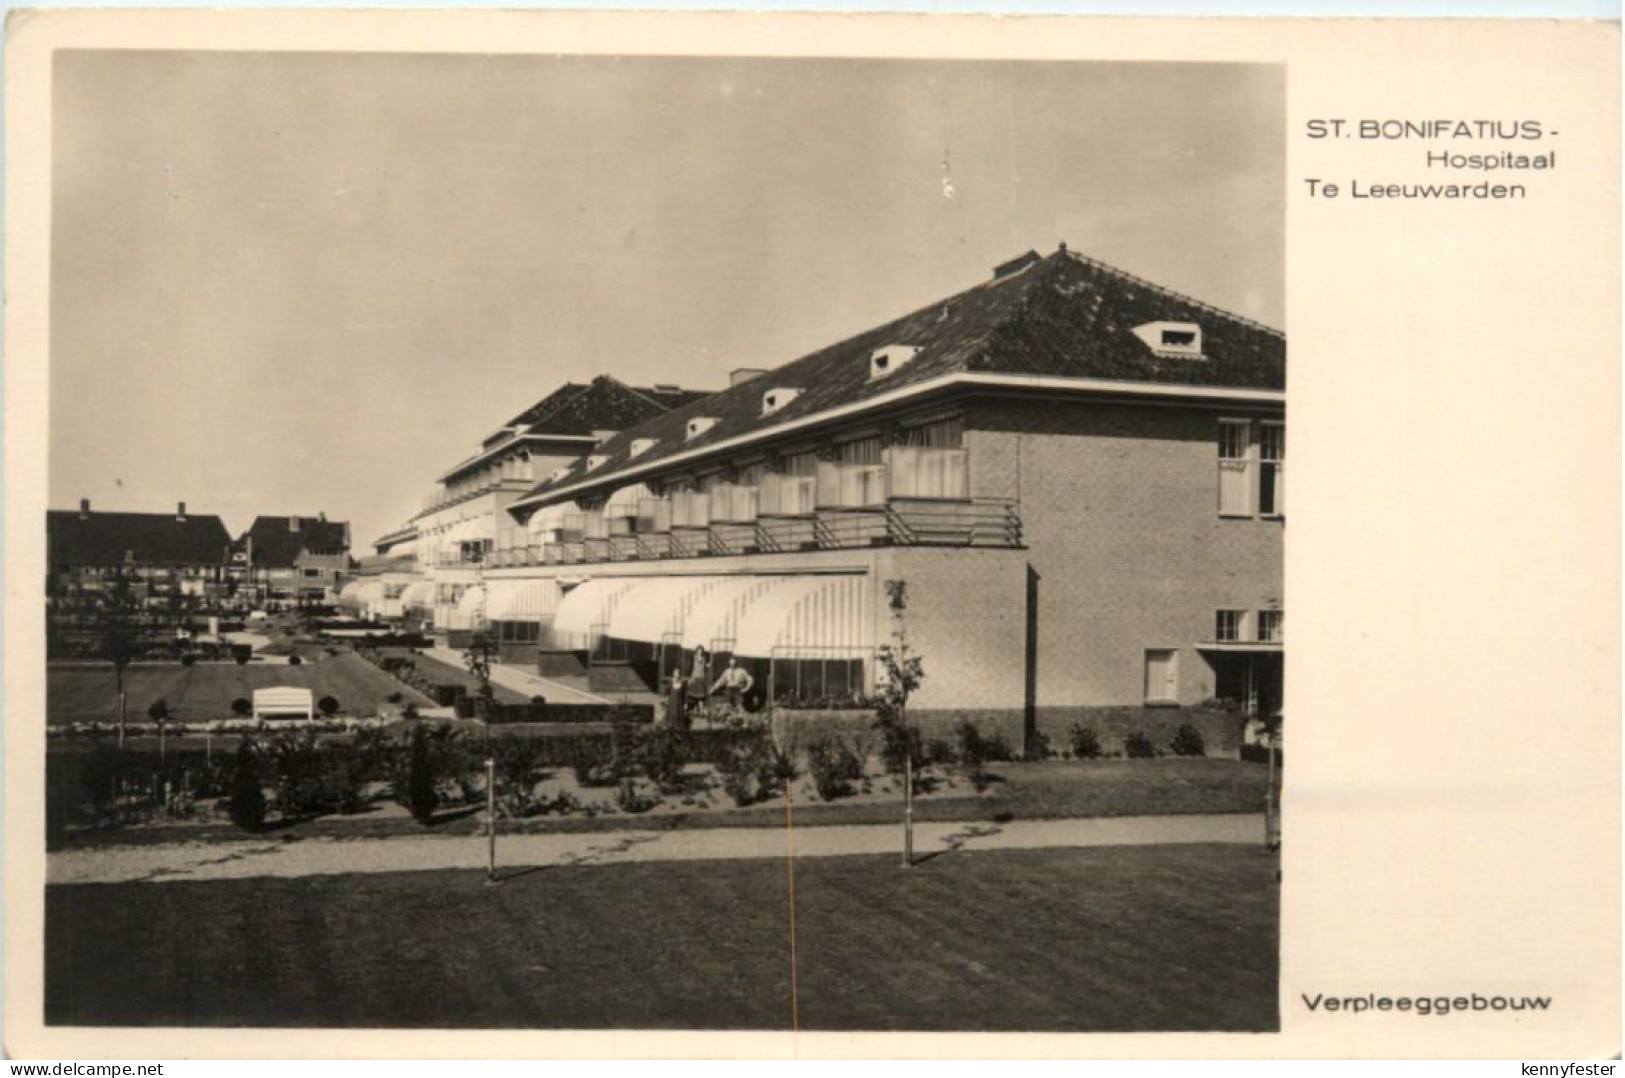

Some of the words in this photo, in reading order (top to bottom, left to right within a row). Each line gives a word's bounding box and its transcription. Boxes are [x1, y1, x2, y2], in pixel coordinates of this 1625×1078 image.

[1306, 119, 1351, 139] ST.
[1360, 119, 1542, 140] BONIFATIUS
[1427, 151, 1556, 171] Hospitaal
[1305, 179, 1339, 198] Te
[1351, 180, 1526, 199] Leeuwarden
[1301, 992, 1553, 1016] Verpleeggebouw
